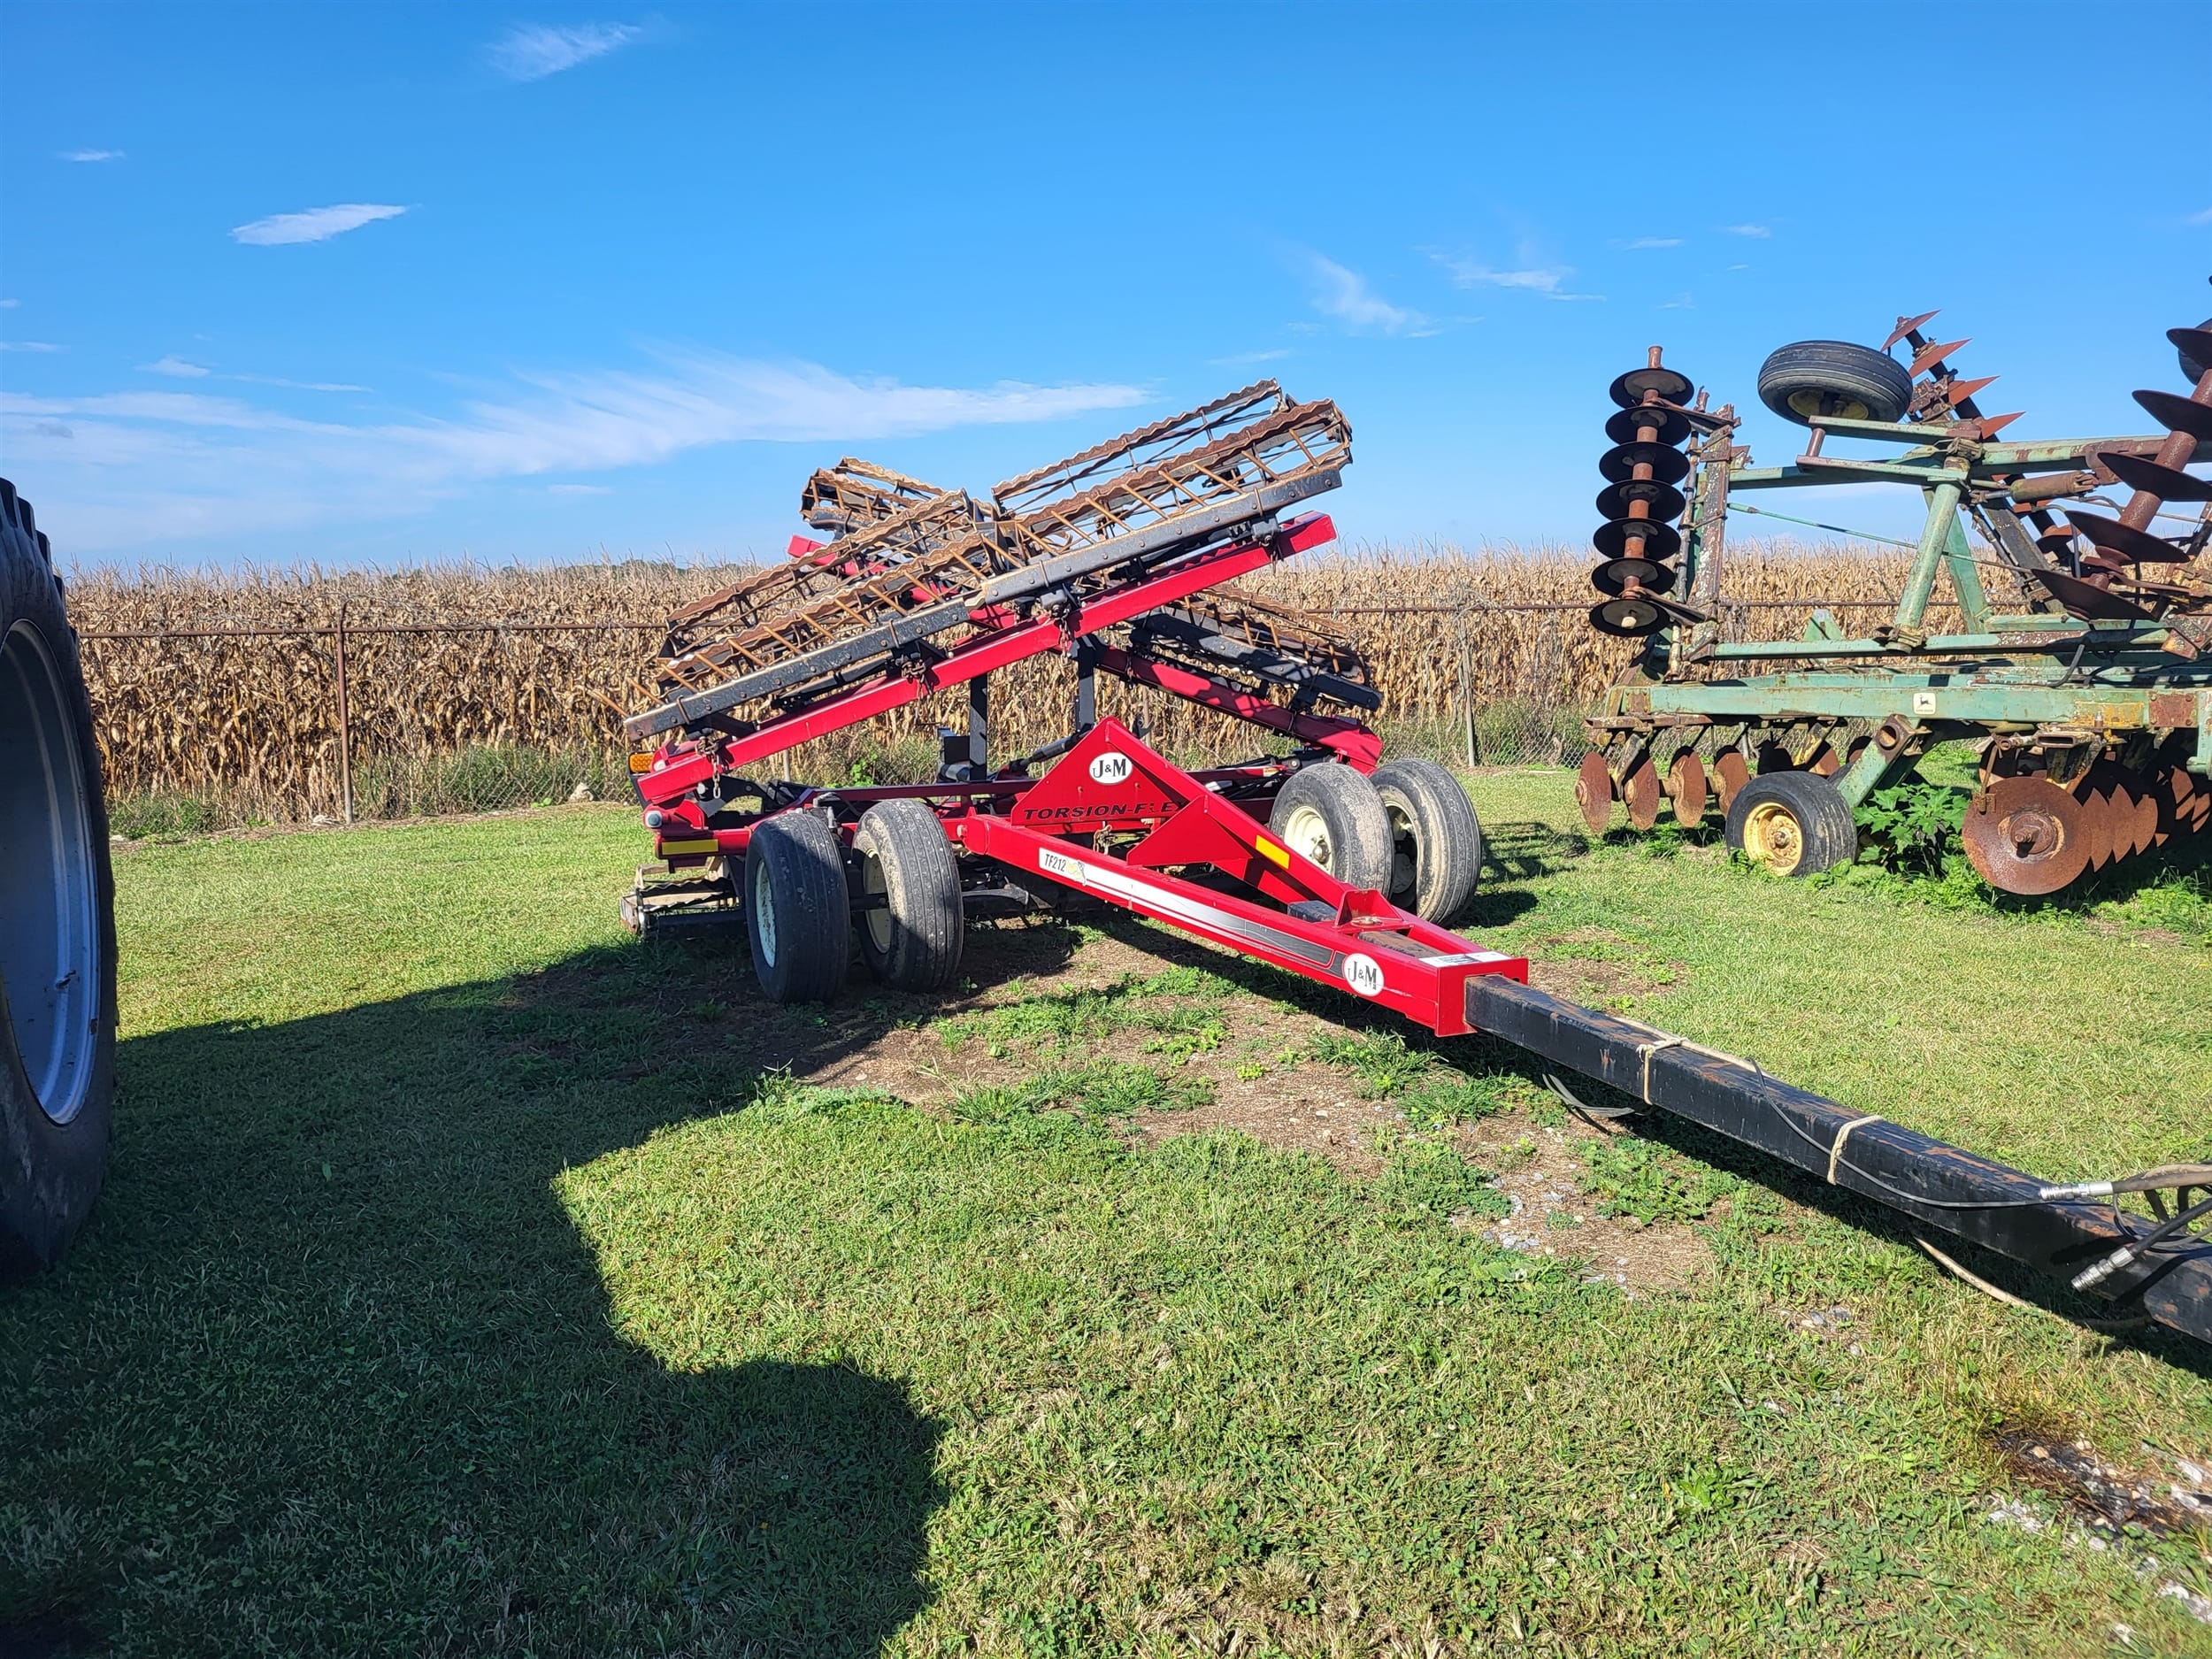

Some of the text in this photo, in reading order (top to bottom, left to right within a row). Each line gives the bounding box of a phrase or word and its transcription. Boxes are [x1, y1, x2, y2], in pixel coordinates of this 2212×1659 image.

[1092, 758, 1126, 779] J&M
[1044, 853, 1067, 872] TF212
[1348, 960, 1377, 990] J&M
